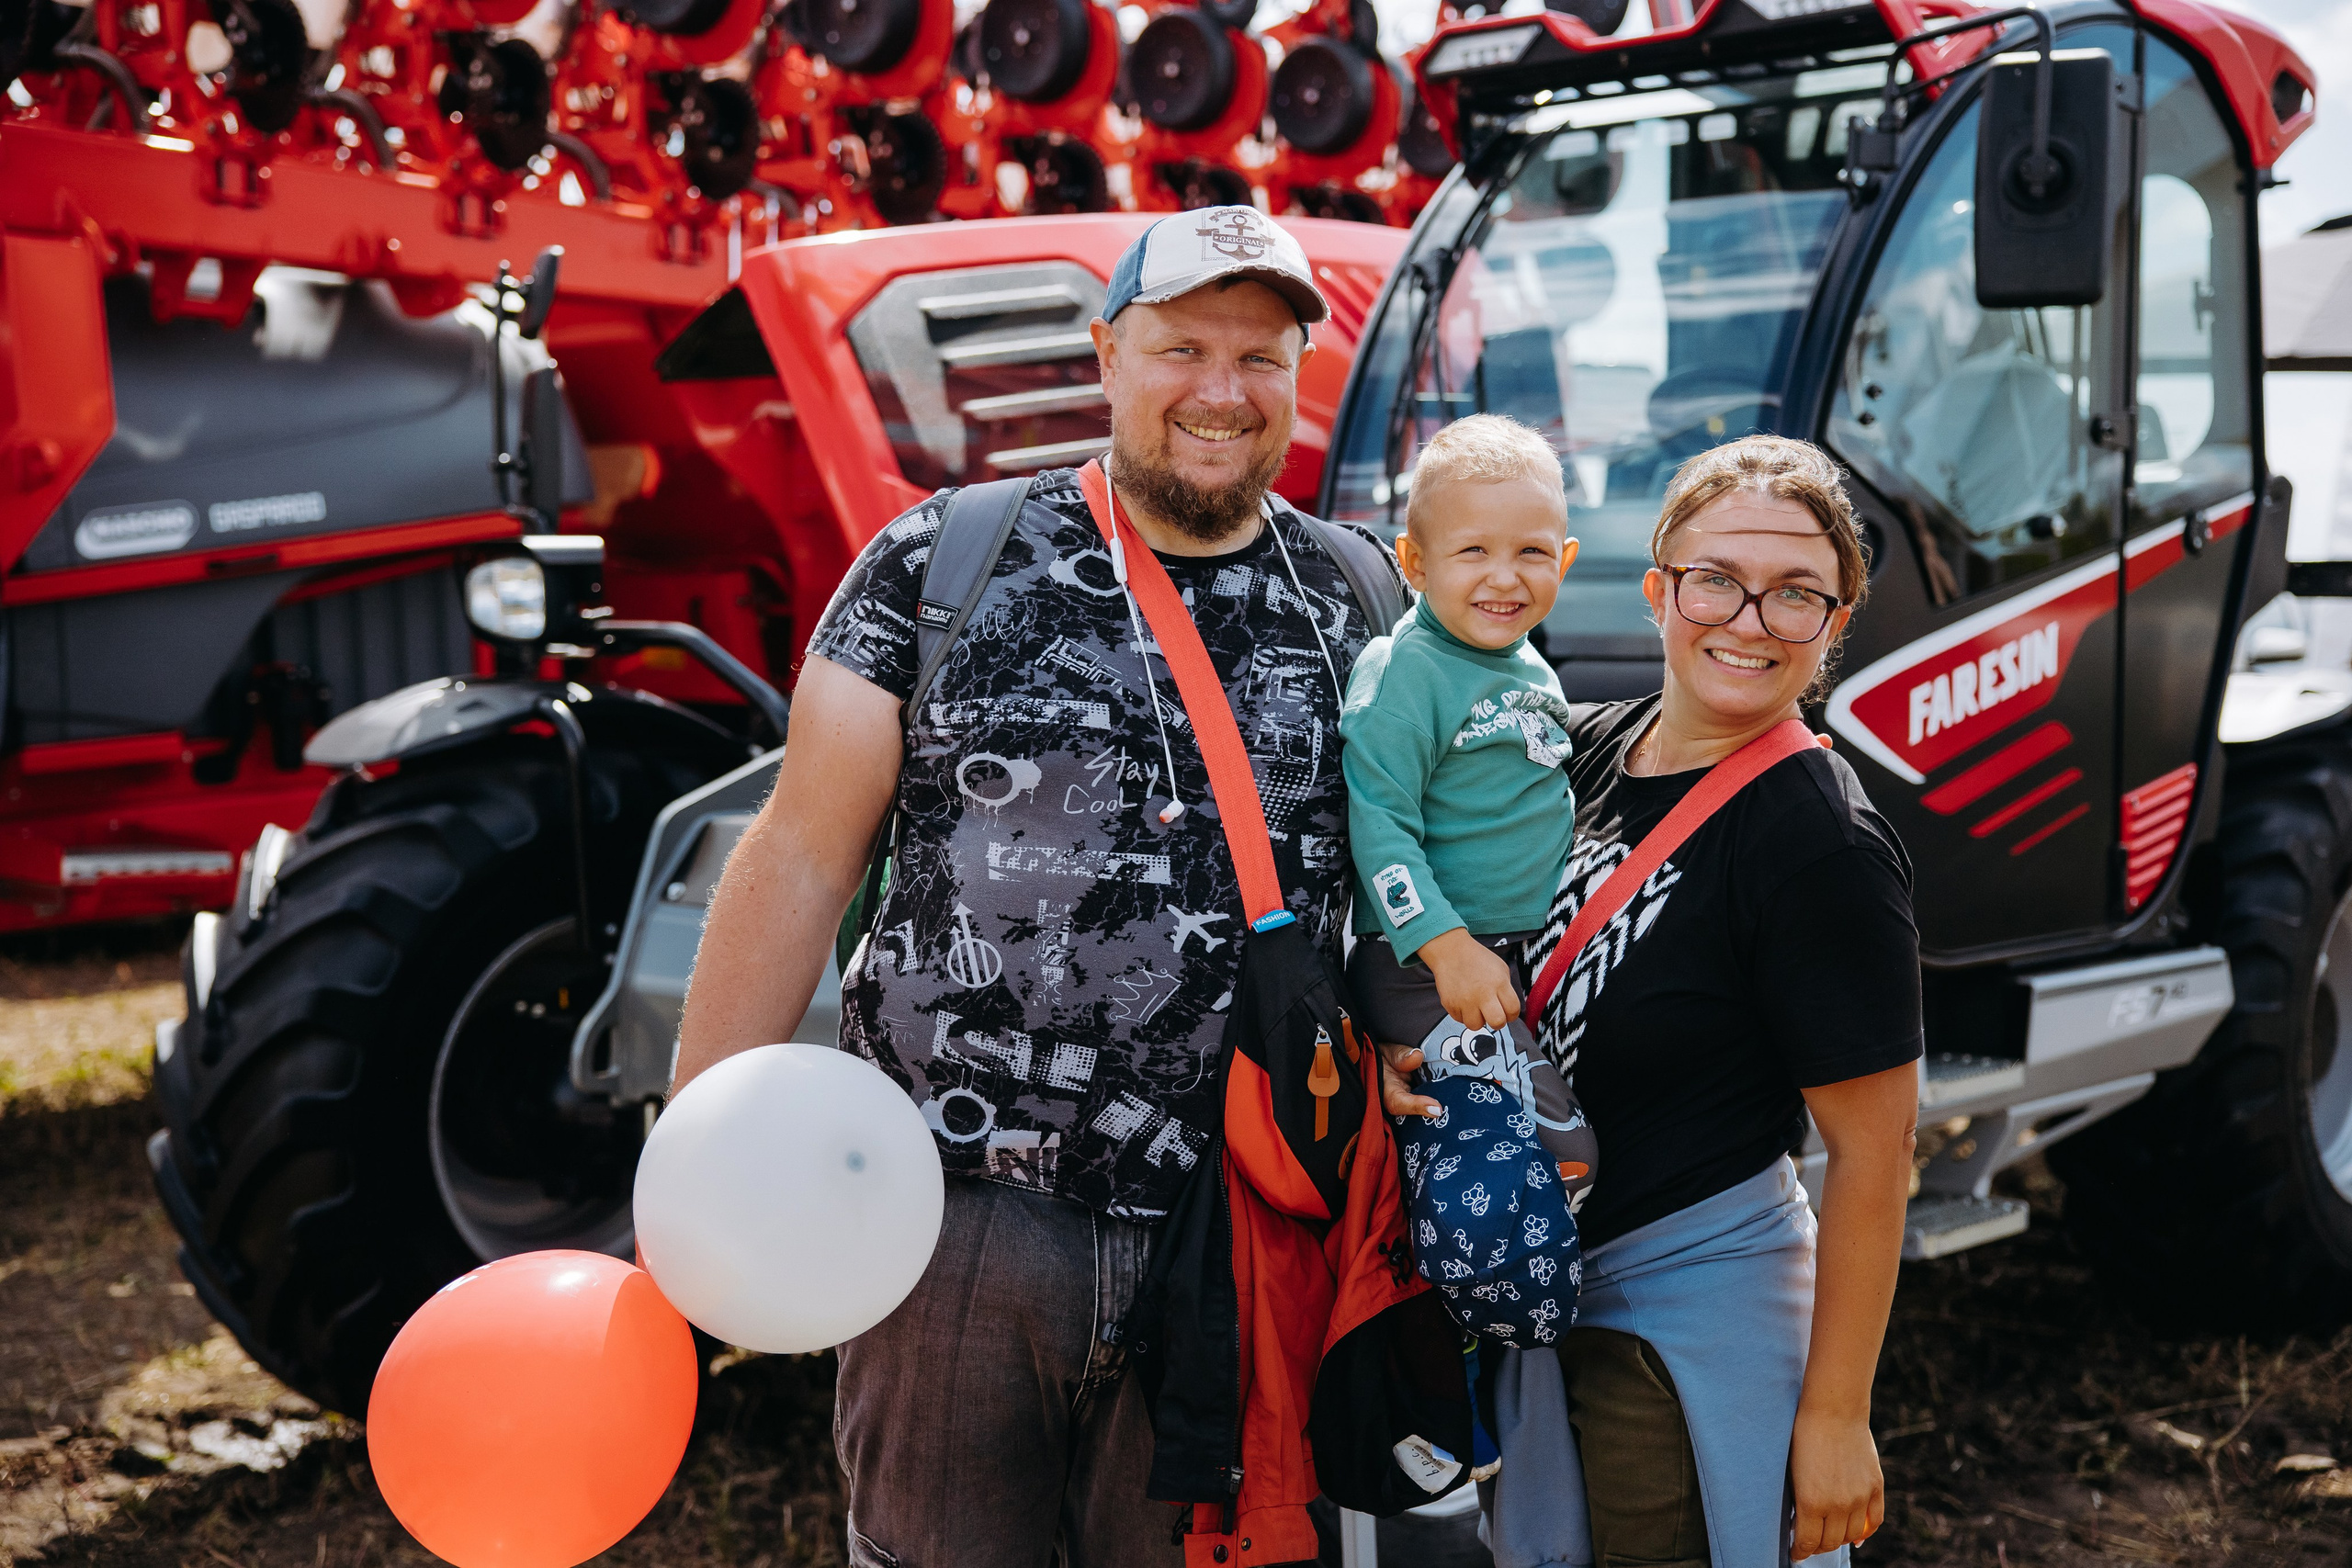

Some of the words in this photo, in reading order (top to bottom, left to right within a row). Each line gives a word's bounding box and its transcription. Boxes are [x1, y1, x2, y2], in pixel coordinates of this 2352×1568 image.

[1219, 235, 1260, 246] ORIGINAL
[1907, 620, 2060, 747] FARESIN
[1084, 744, 1159, 799] Stay
[1255, 911, 1291, 926] FASHION
